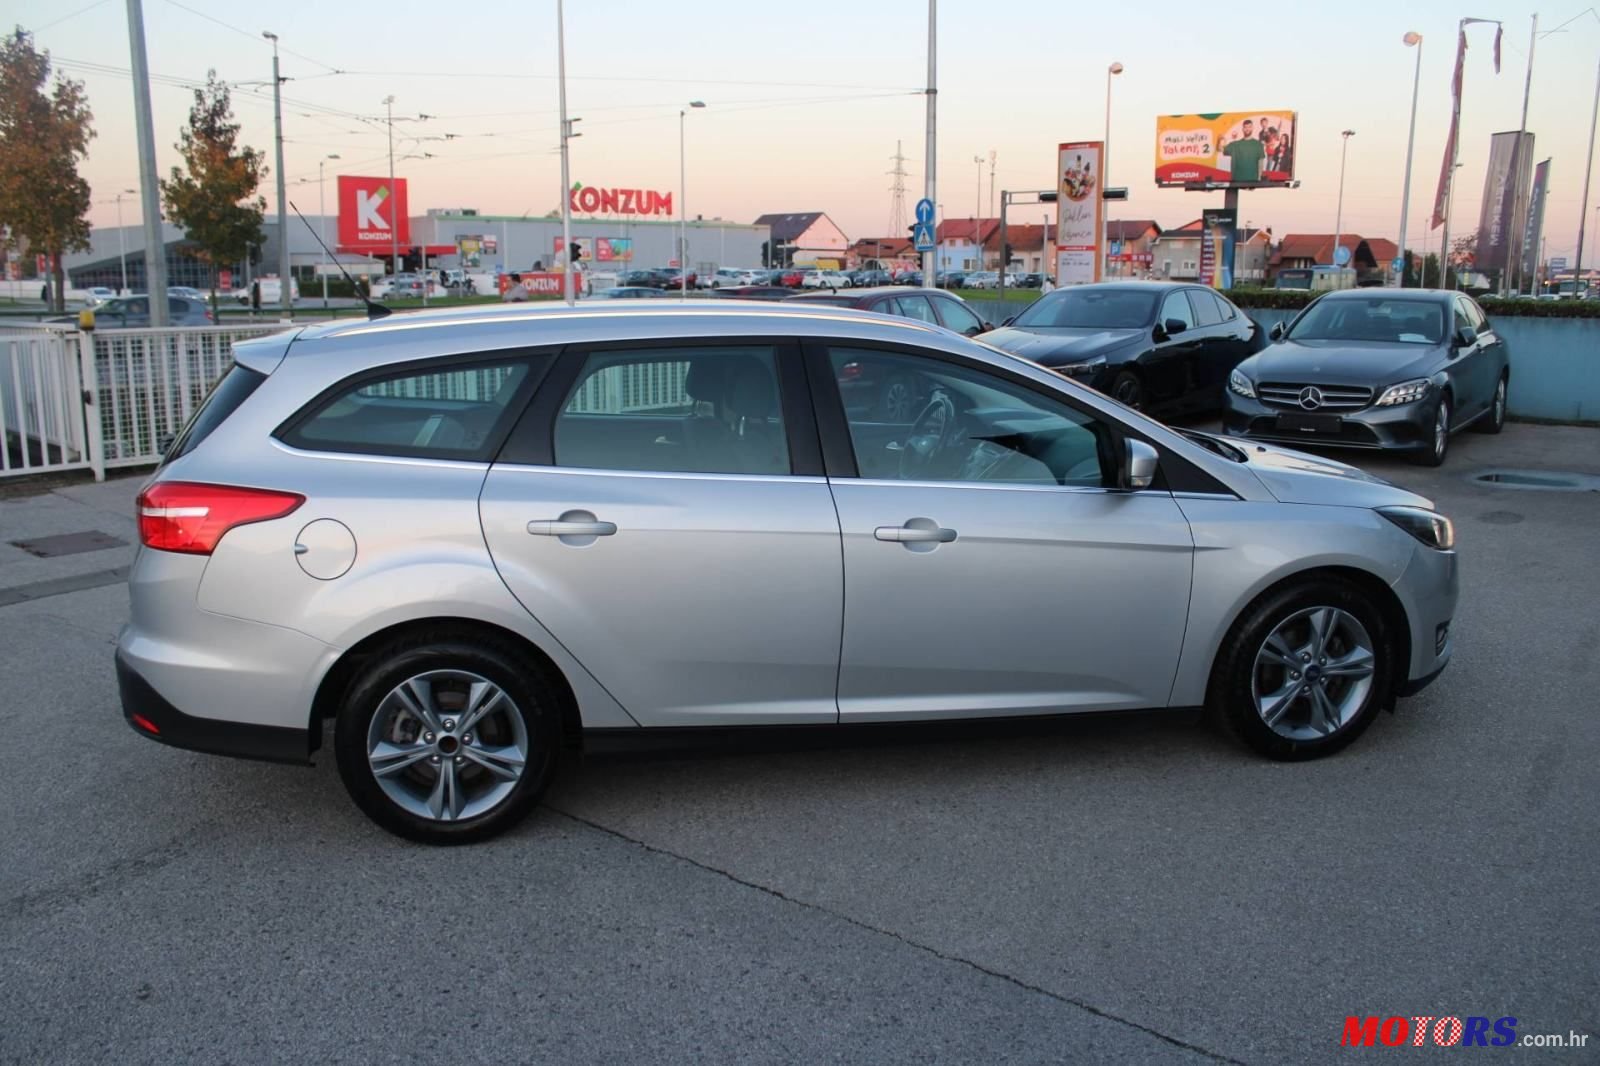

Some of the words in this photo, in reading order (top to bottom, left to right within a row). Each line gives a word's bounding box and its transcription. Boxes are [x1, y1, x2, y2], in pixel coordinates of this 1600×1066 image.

[1202, 143, 1210, 154] 2
[356, 186, 391, 229] K
[569, 182, 673, 216] KONZUM
[358, 232, 392, 240] KONZUM
